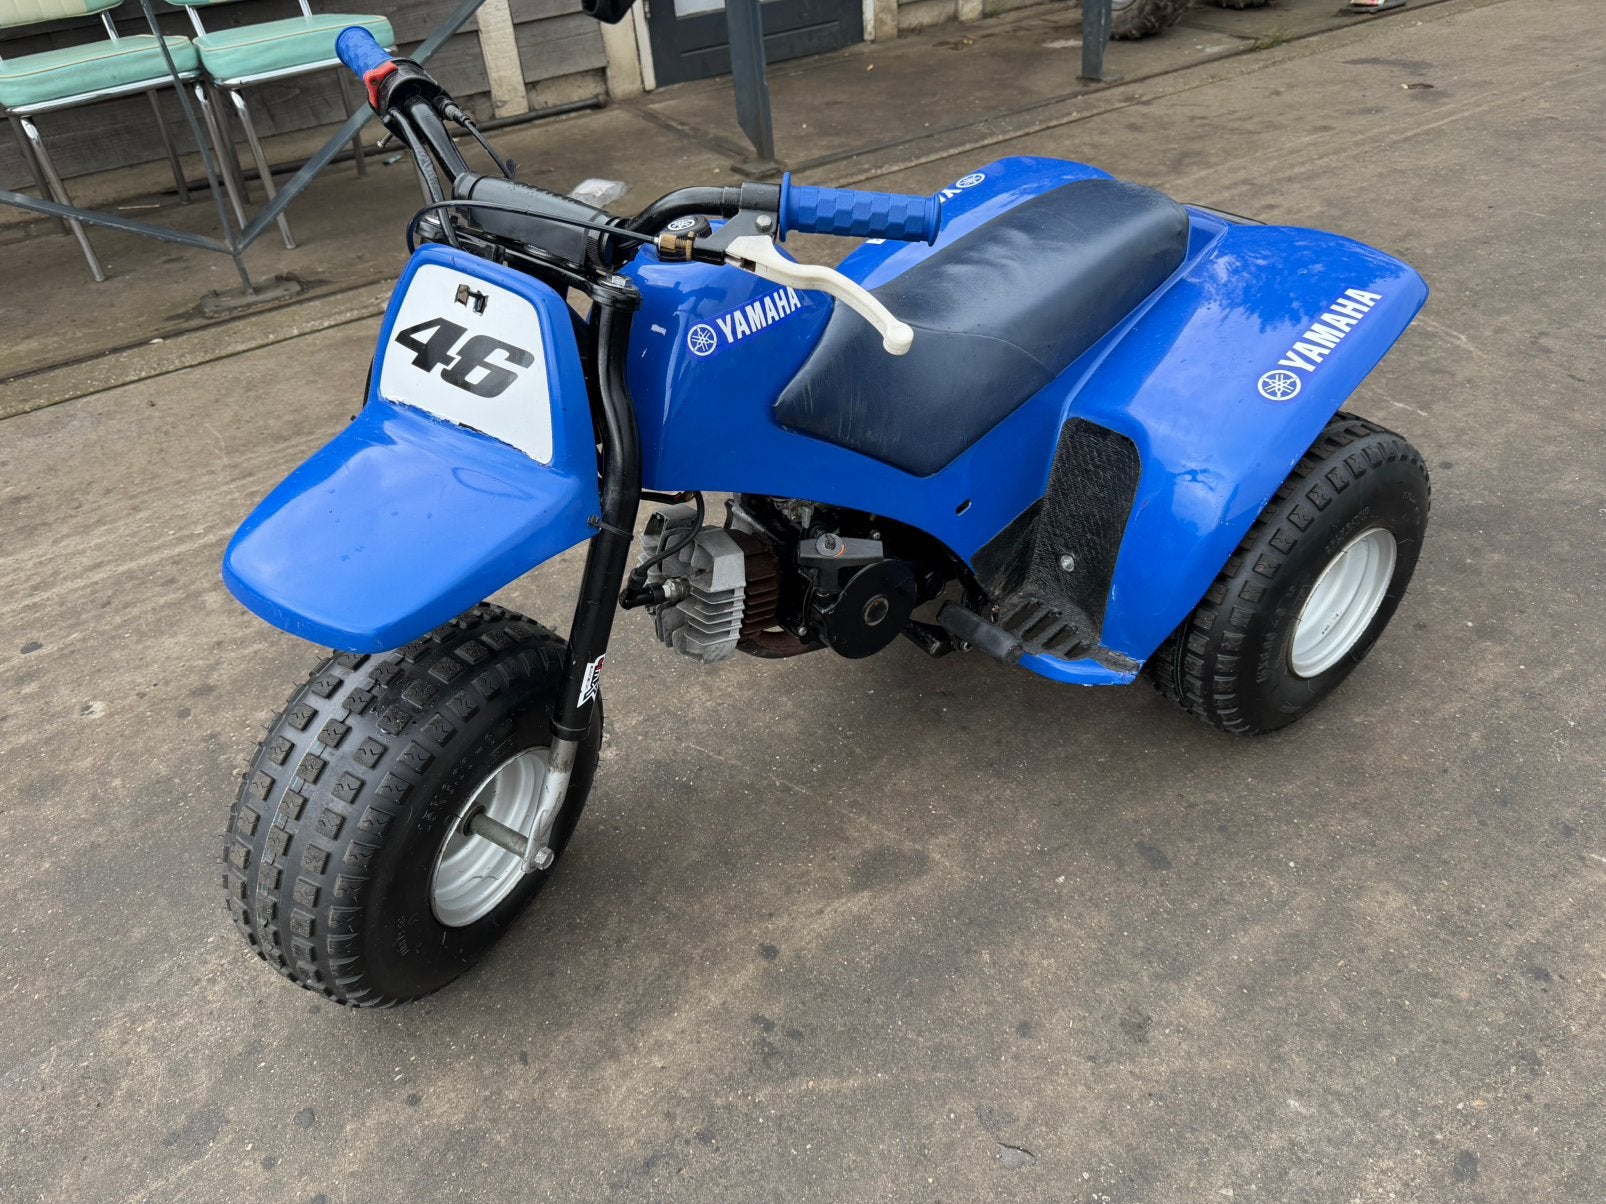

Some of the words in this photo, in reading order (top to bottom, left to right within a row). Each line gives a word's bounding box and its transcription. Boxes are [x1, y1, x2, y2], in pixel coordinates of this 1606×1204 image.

[716, 286, 802, 344] YAMAHA
[1277, 288, 1383, 373] YAMAHA
[394, 316, 535, 399] 46
